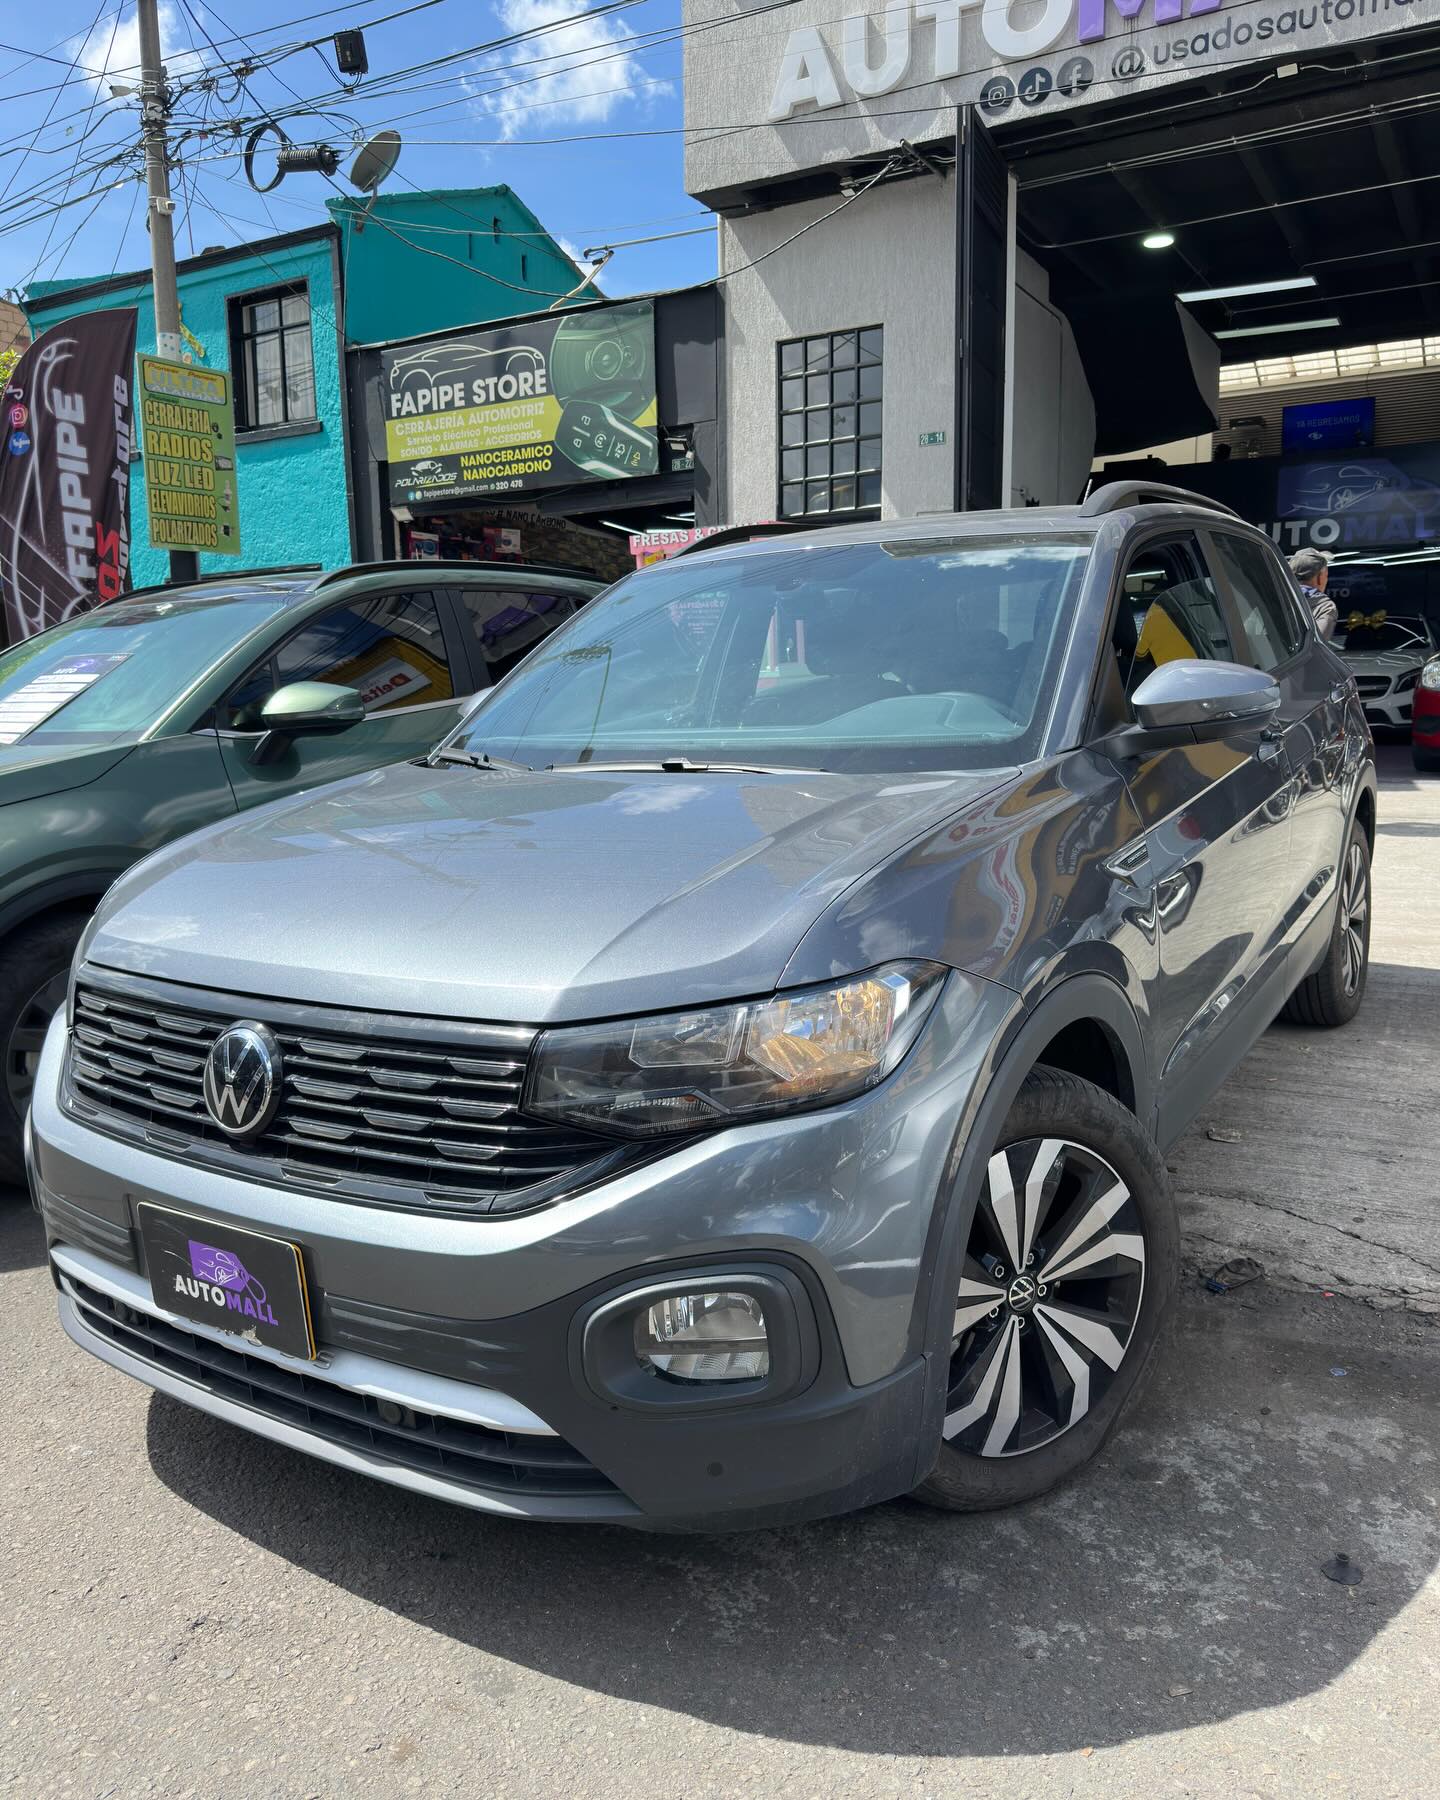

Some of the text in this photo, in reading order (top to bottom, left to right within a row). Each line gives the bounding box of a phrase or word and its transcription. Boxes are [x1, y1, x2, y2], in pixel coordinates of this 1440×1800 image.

[768, 0, 1222, 123] AUTO
[391, 369, 547, 417] FAPIPE STORE
[145, 399, 212, 434] CERRAJERIA
[468, 402, 545, 425] AUTOMOTRIZ
[146, 429, 214, 463] RADIOS
[400, 430, 542, 458] SONIDO ALARMAS ACCESORIOS
[460, 444, 553, 467] NANOCERAMICO
[53, 387, 97, 579] FAPIPE
[148, 459, 215, 491] LUZ LED
[463, 459, 552, 481] NANOCARBONO
[150, 488, 216, 520] ELEVAVIDRIOS
[152, 517, 218, 547] POLARIZADOS
[633, 530, 689, 548] FRESAS
[1257, 511, 1439, 547] UTOMAL
[174, 1272, 279, 1327] AUTOMALL
